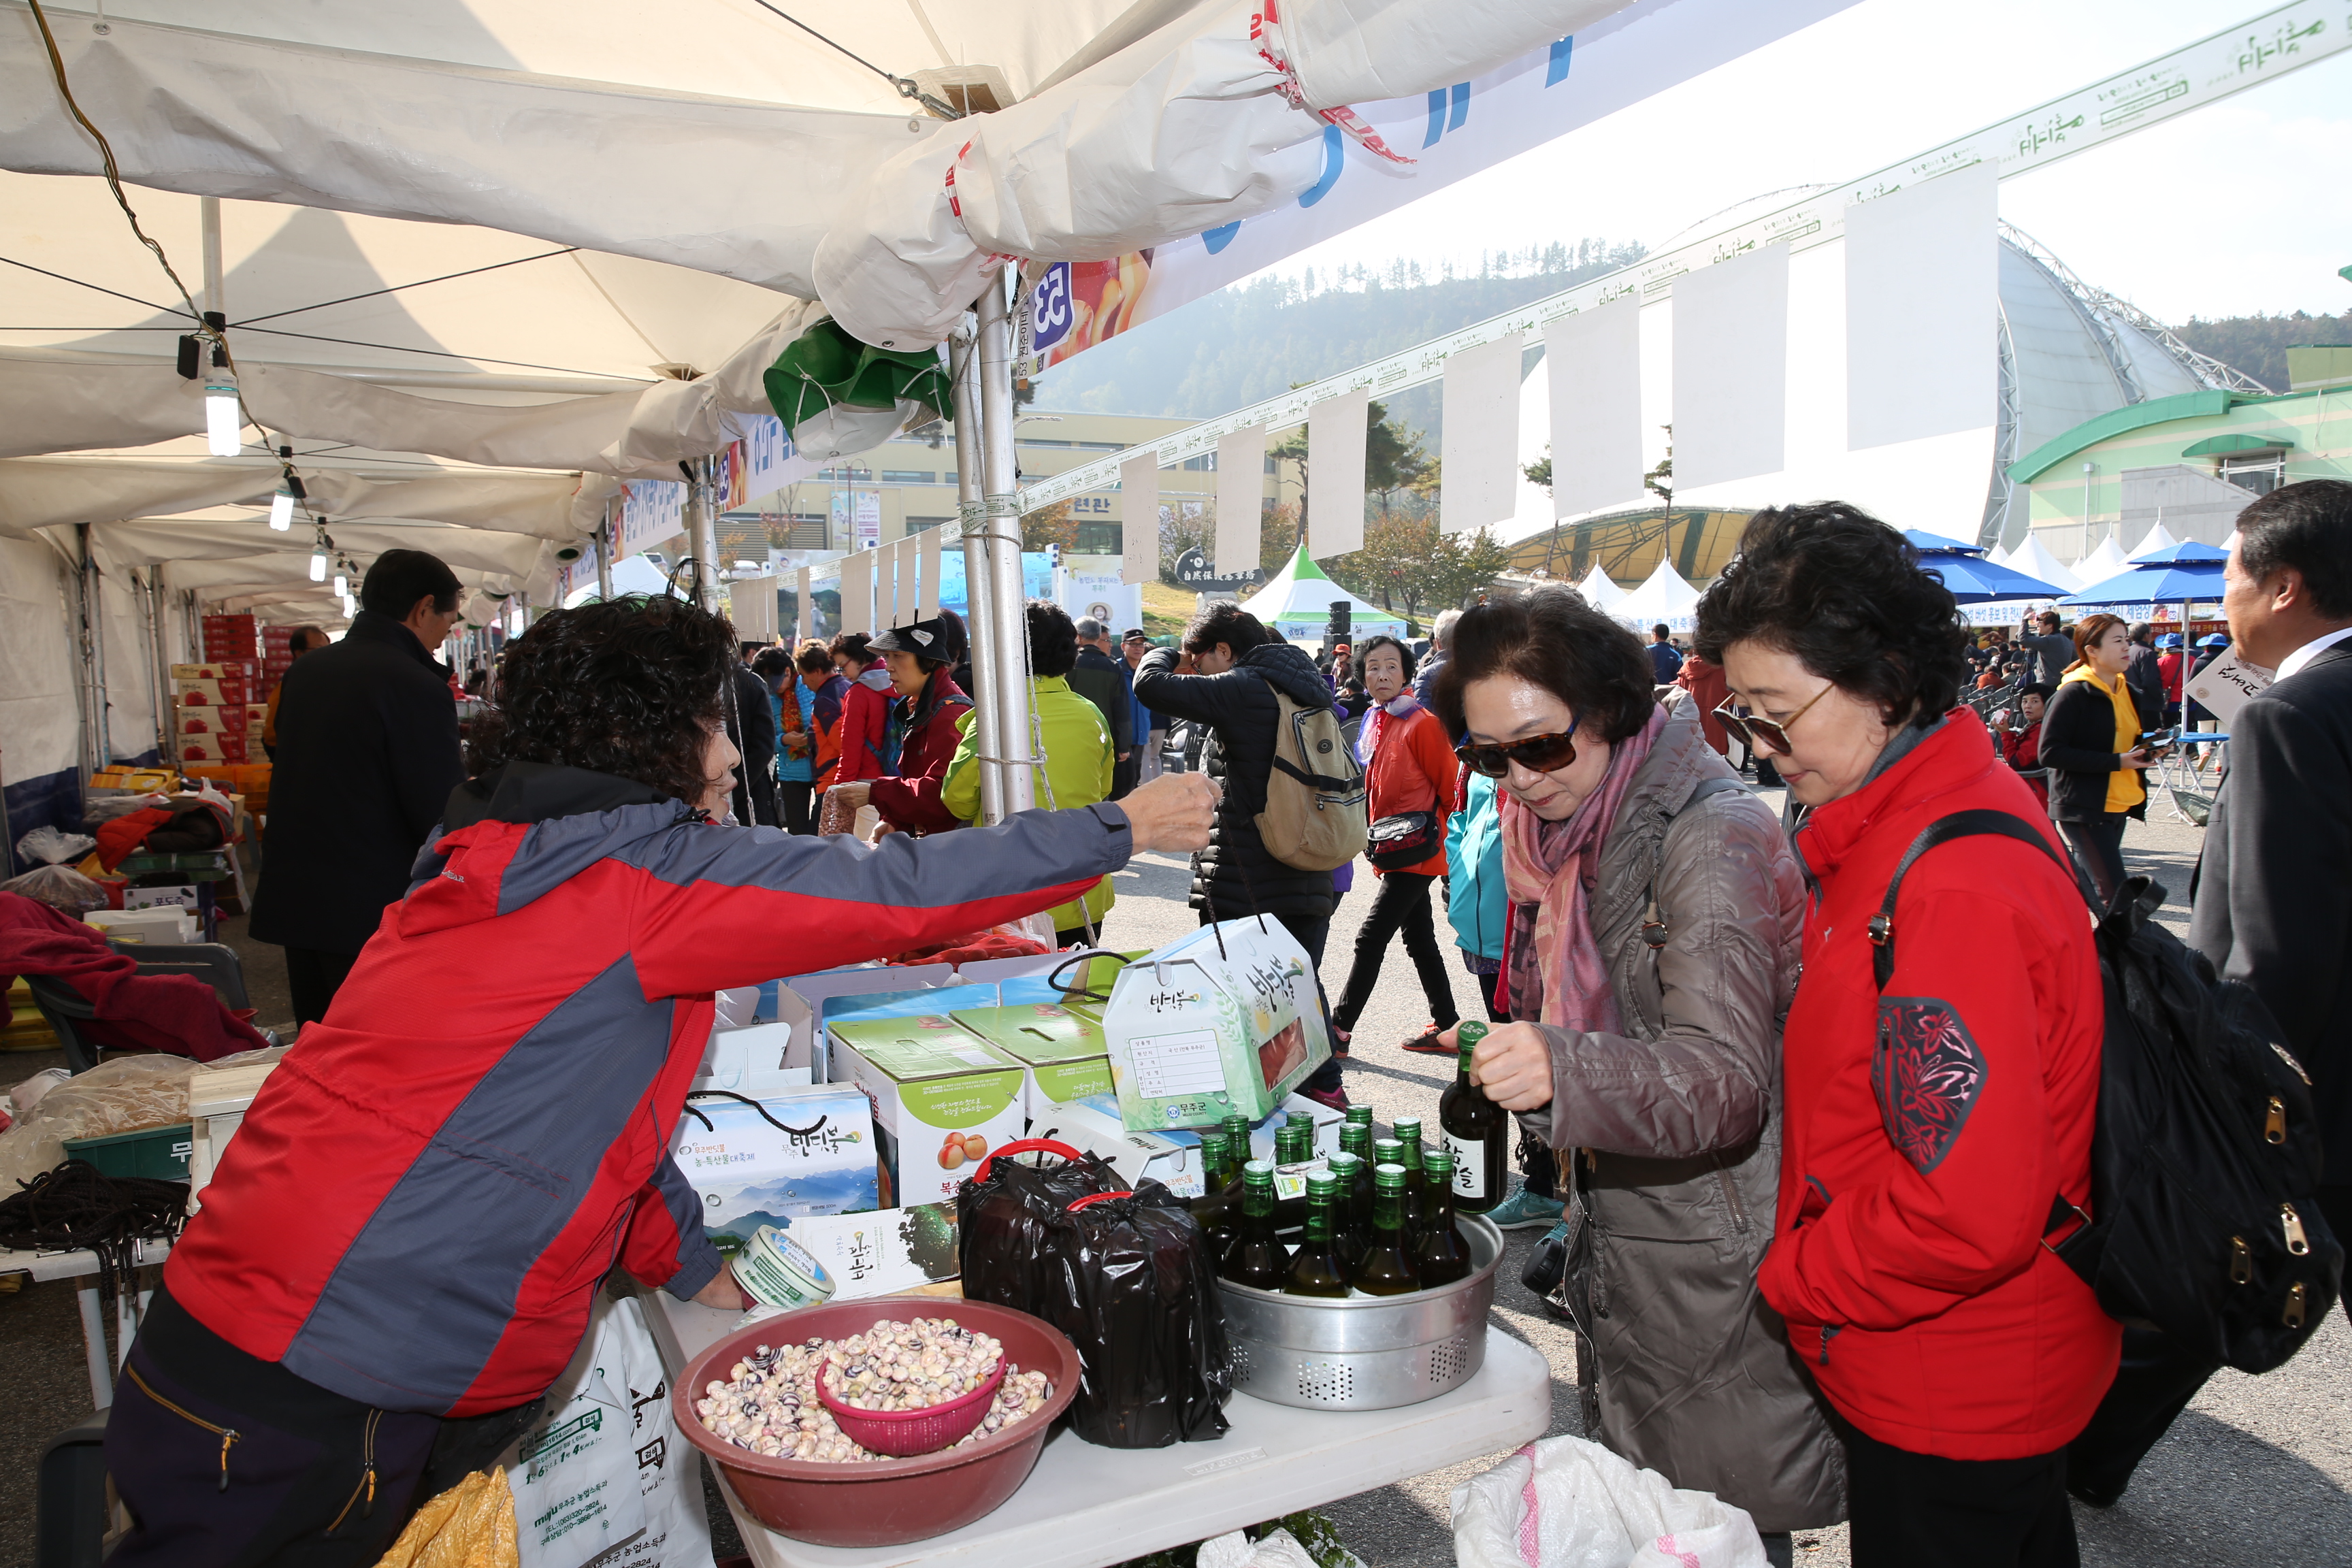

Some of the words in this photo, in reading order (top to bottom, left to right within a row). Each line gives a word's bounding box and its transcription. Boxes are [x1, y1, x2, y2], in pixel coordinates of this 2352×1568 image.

[1034, 267, 1065, 333] 53
[1989, 606, 2000, 622] 홍보
[1180, 1102, 1207, 1113] 무주군
[695, 1143, 725, 1154] 무주반딧불
[1128, 1137, 1159, 1150] muju
[1165, 1174, 1193, 1187] 무주반딧불
[559, 1496, 576, 1509] 무주군
[578, 1480, 607, 1501] 농업소득과
[624, 1532, 666, 1556] 농업소득과
